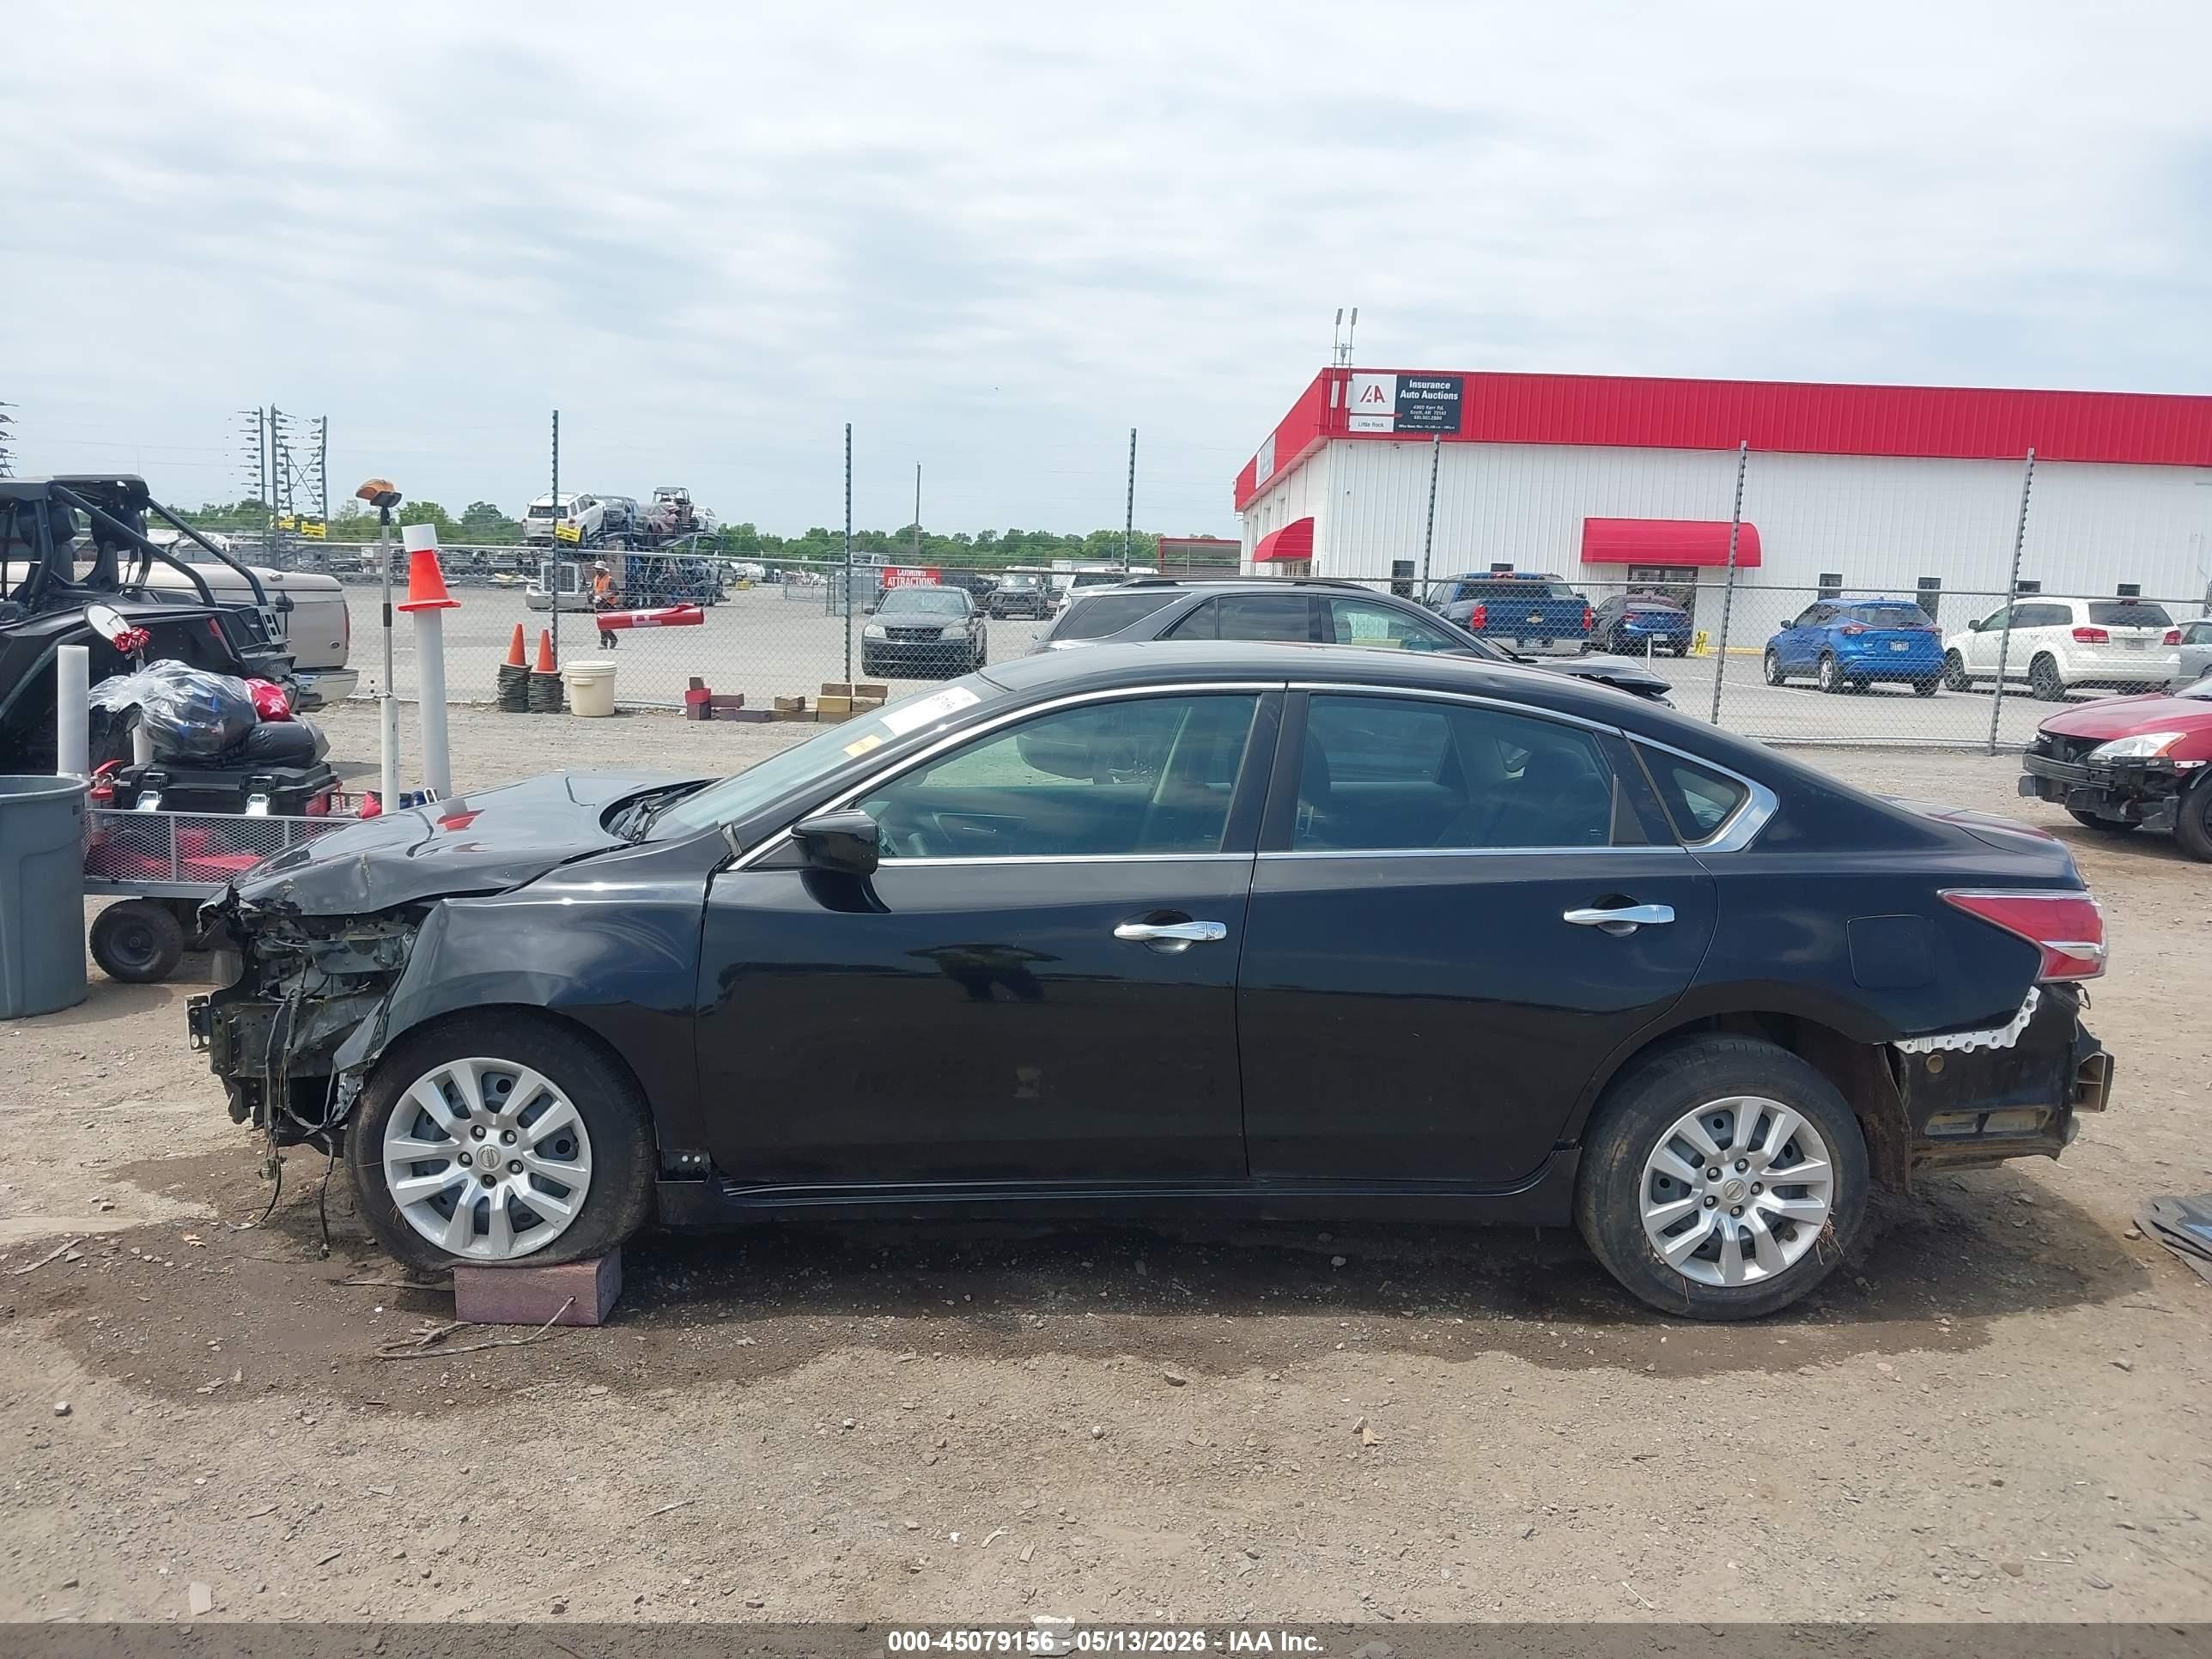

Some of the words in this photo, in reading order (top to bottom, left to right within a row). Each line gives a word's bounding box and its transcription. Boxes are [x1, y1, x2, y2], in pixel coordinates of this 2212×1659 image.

[1410, 380, 1451, 390] Insurance
[1400, 391, 1419, 399] Auto
[1421, 391, 1459, 400] Auctions
[887, 577, 937, 587] ATTRACTIONS
